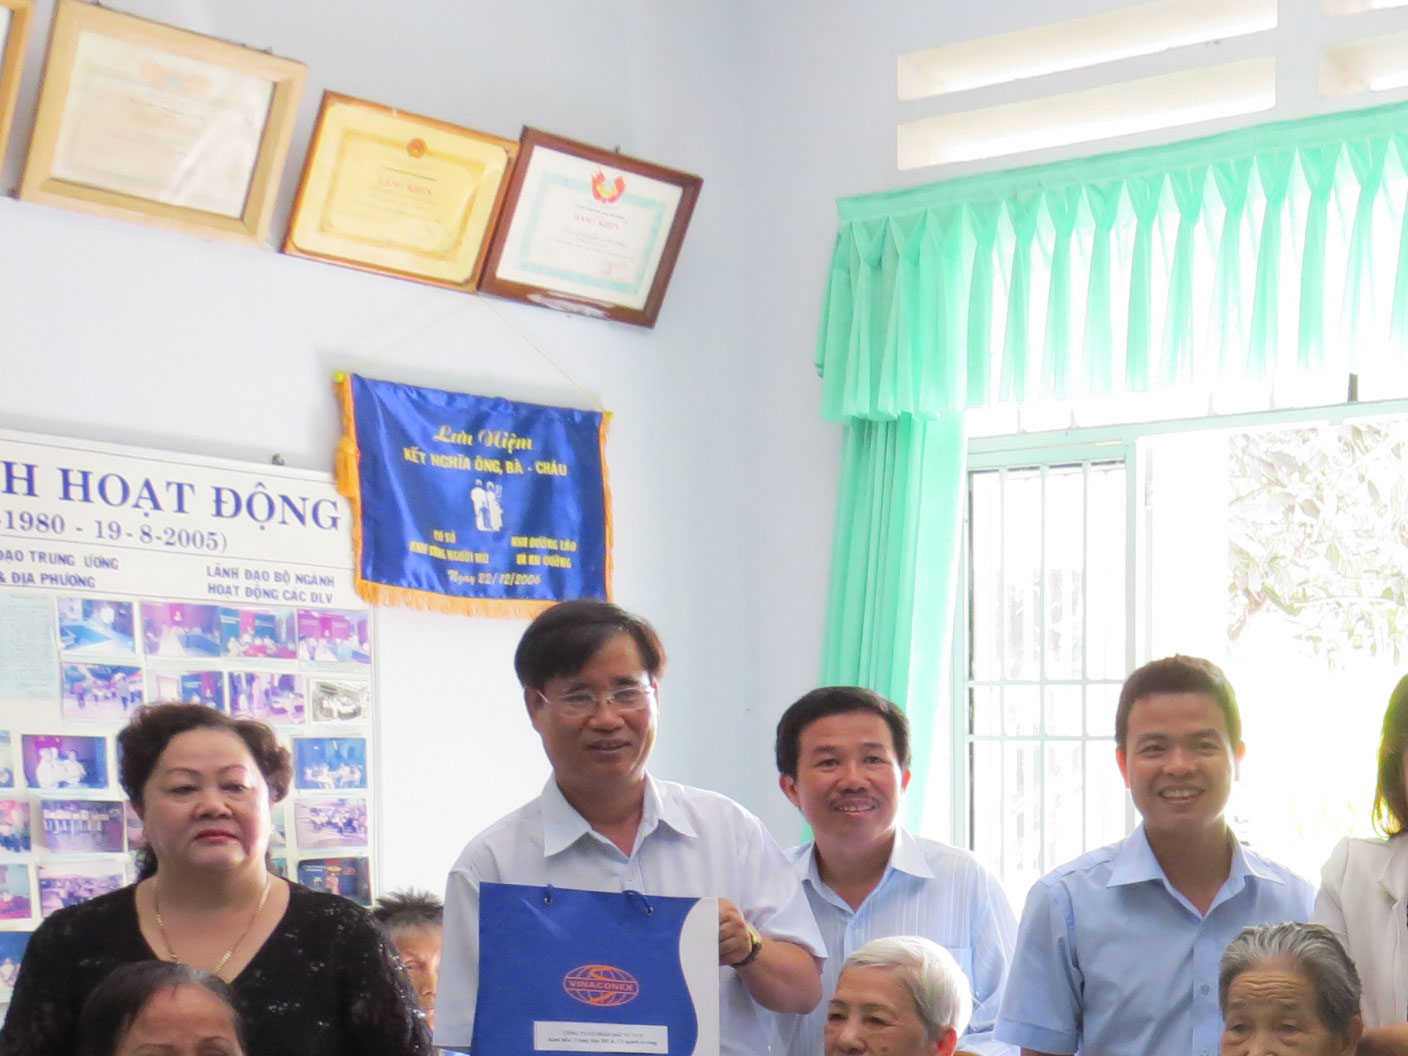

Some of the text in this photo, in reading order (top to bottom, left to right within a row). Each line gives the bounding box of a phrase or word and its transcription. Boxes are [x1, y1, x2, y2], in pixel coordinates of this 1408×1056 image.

[505, 458, 524, 475] BÀ
[57, 467, 195, 518] HOẠT
[211, 481, 341, 531] ĐỘNG
[0, 510, 66, 535] 1980
[29, 550, 75, 566] TRUNG
[244, 583, 279, 601] ĐỘNG
[282, 587, 307, 603] CÁC
[569, 979, 633, 991] VINACONEX
